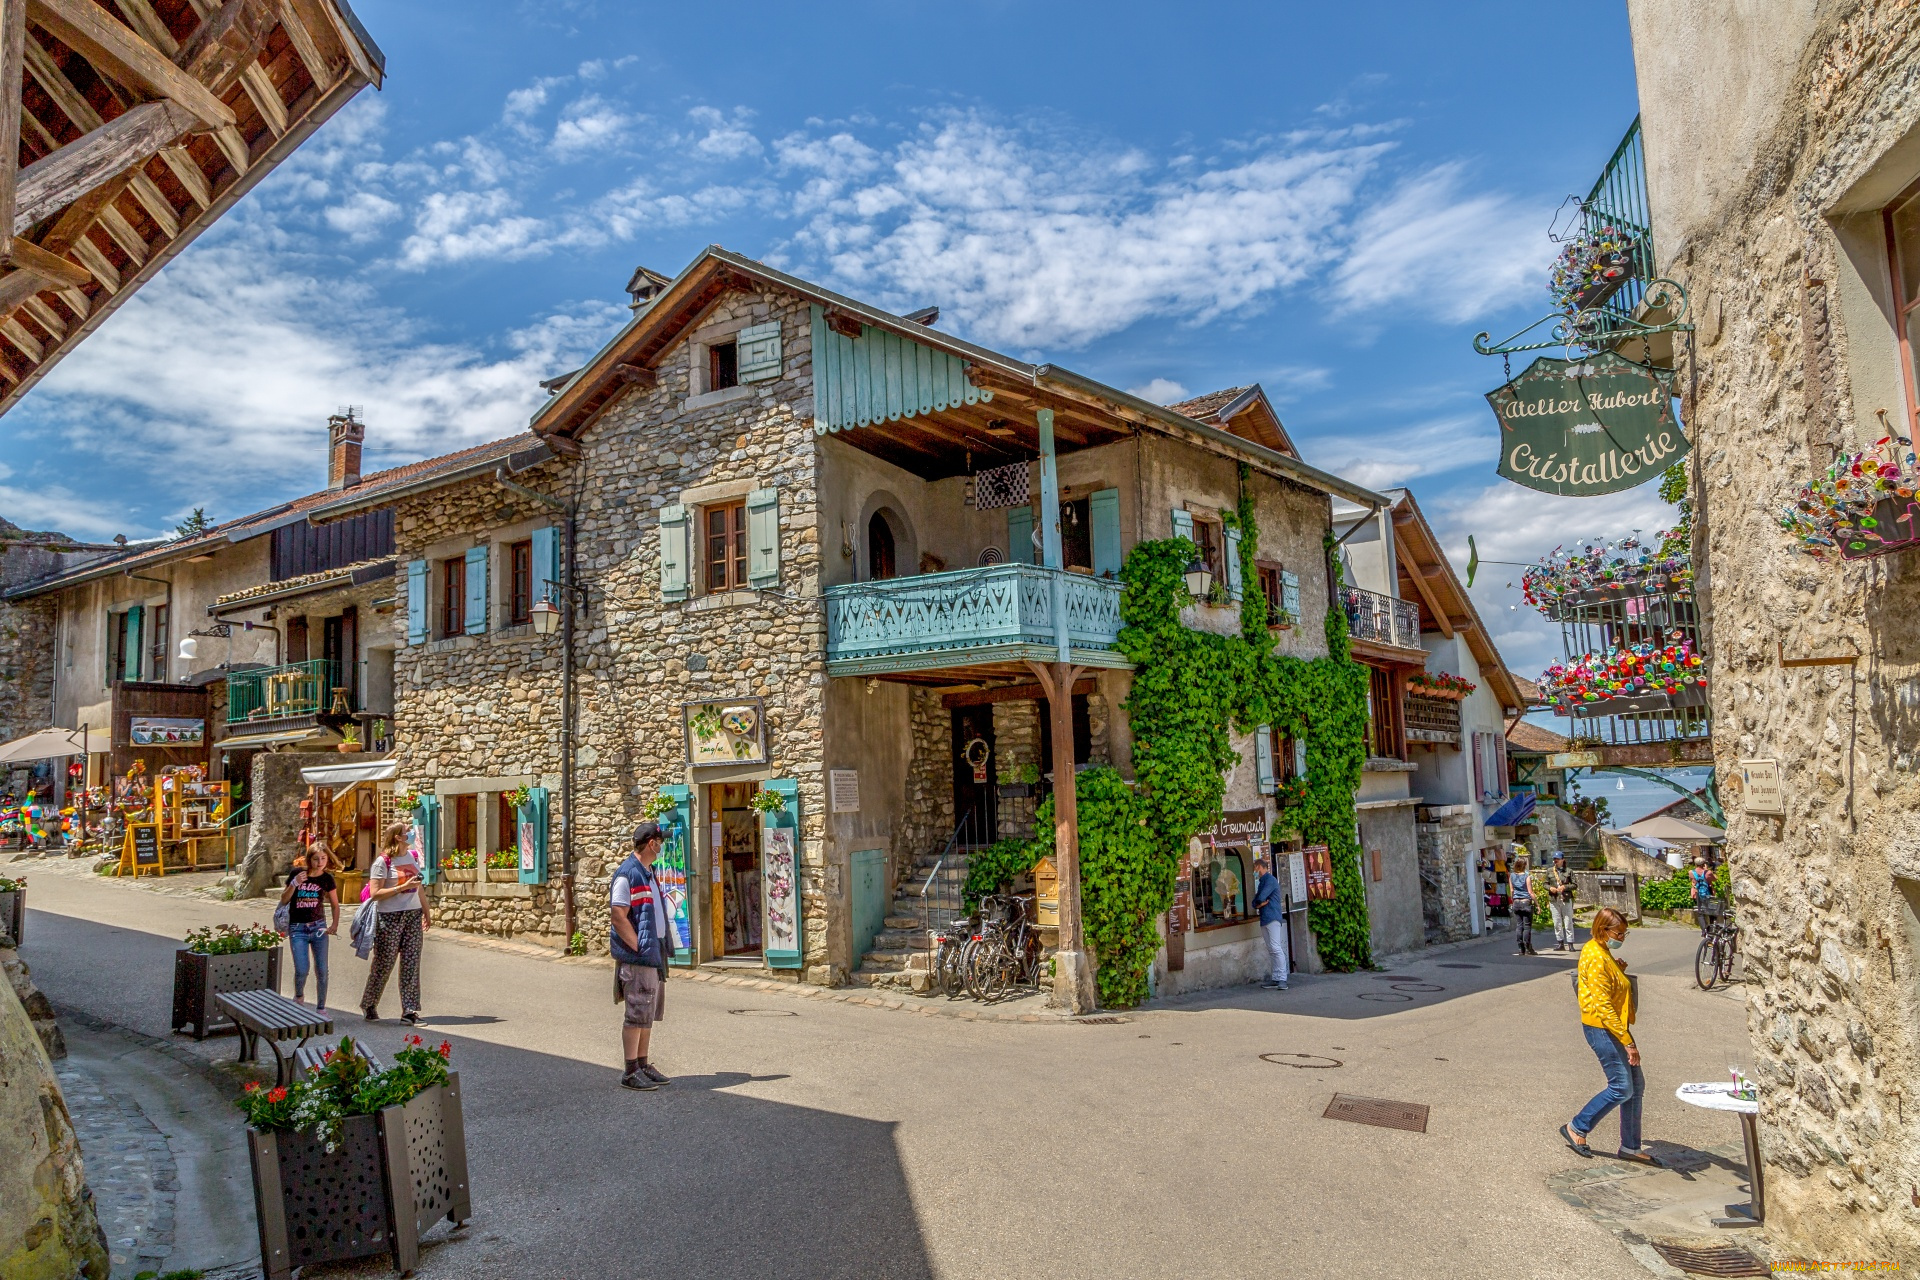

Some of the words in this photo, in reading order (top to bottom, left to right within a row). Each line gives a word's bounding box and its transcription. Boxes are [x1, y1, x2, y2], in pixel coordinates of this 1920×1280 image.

[1505, 398, 1582, 419] Atelier
[1587, 387, 1662, 411] Hubert
[1509, 432, 1677, 485] Cristallerie
[1220, 816, 1265, 836] Gourmande
